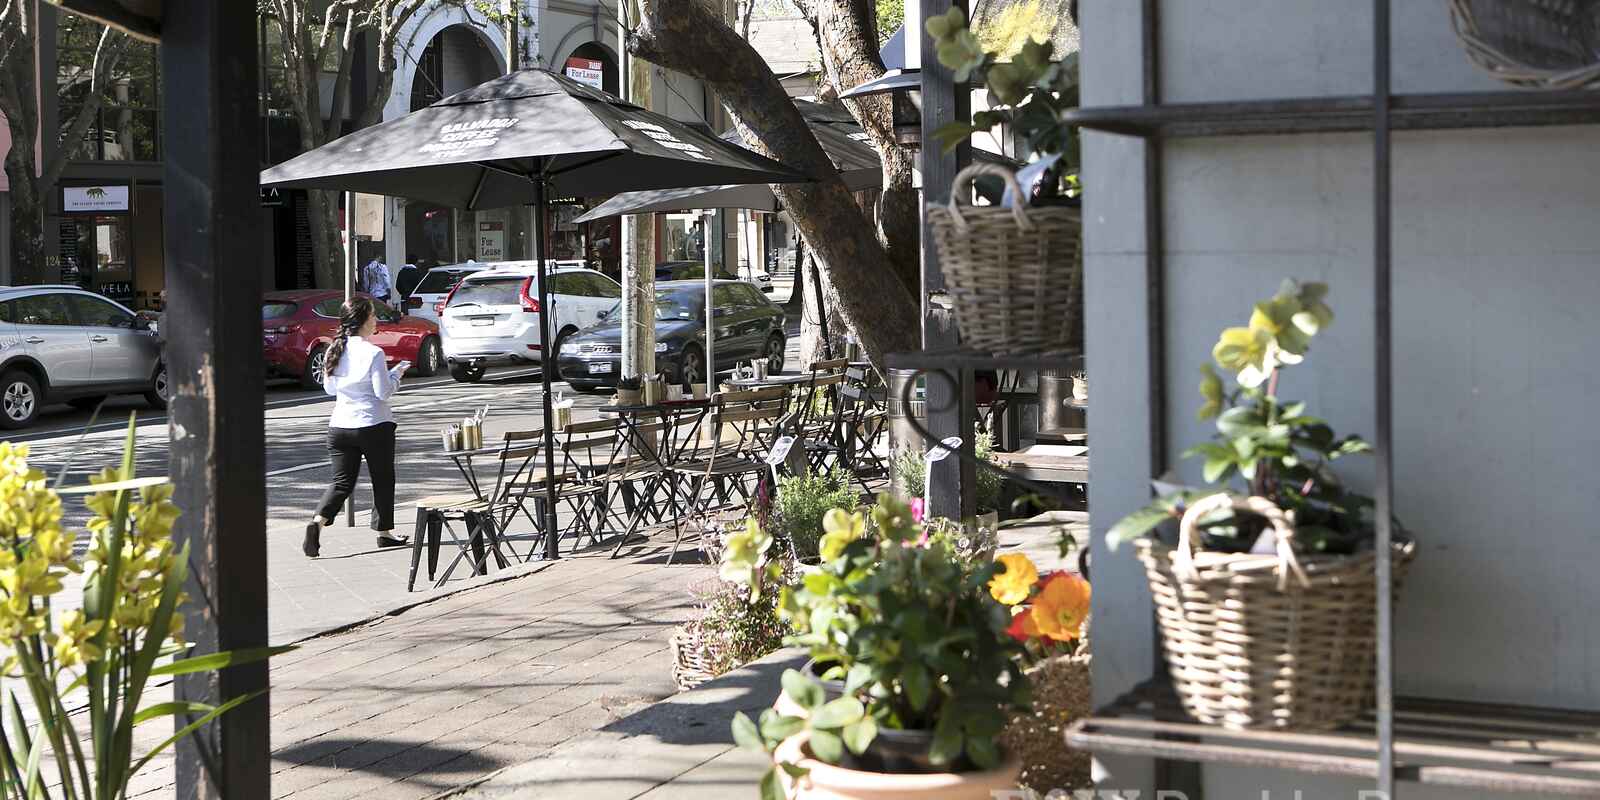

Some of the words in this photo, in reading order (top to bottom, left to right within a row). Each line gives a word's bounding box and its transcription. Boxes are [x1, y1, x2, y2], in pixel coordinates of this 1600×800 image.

[571, 69, 582, 78] For
[583, 70, 600, 80] Lease
[440, 118, 519, 134] SALVADOR
[440, 128, 500, 142] COFFEE
[481, 236, 493, 247] For
[481, 248, 502, 257] Lease
